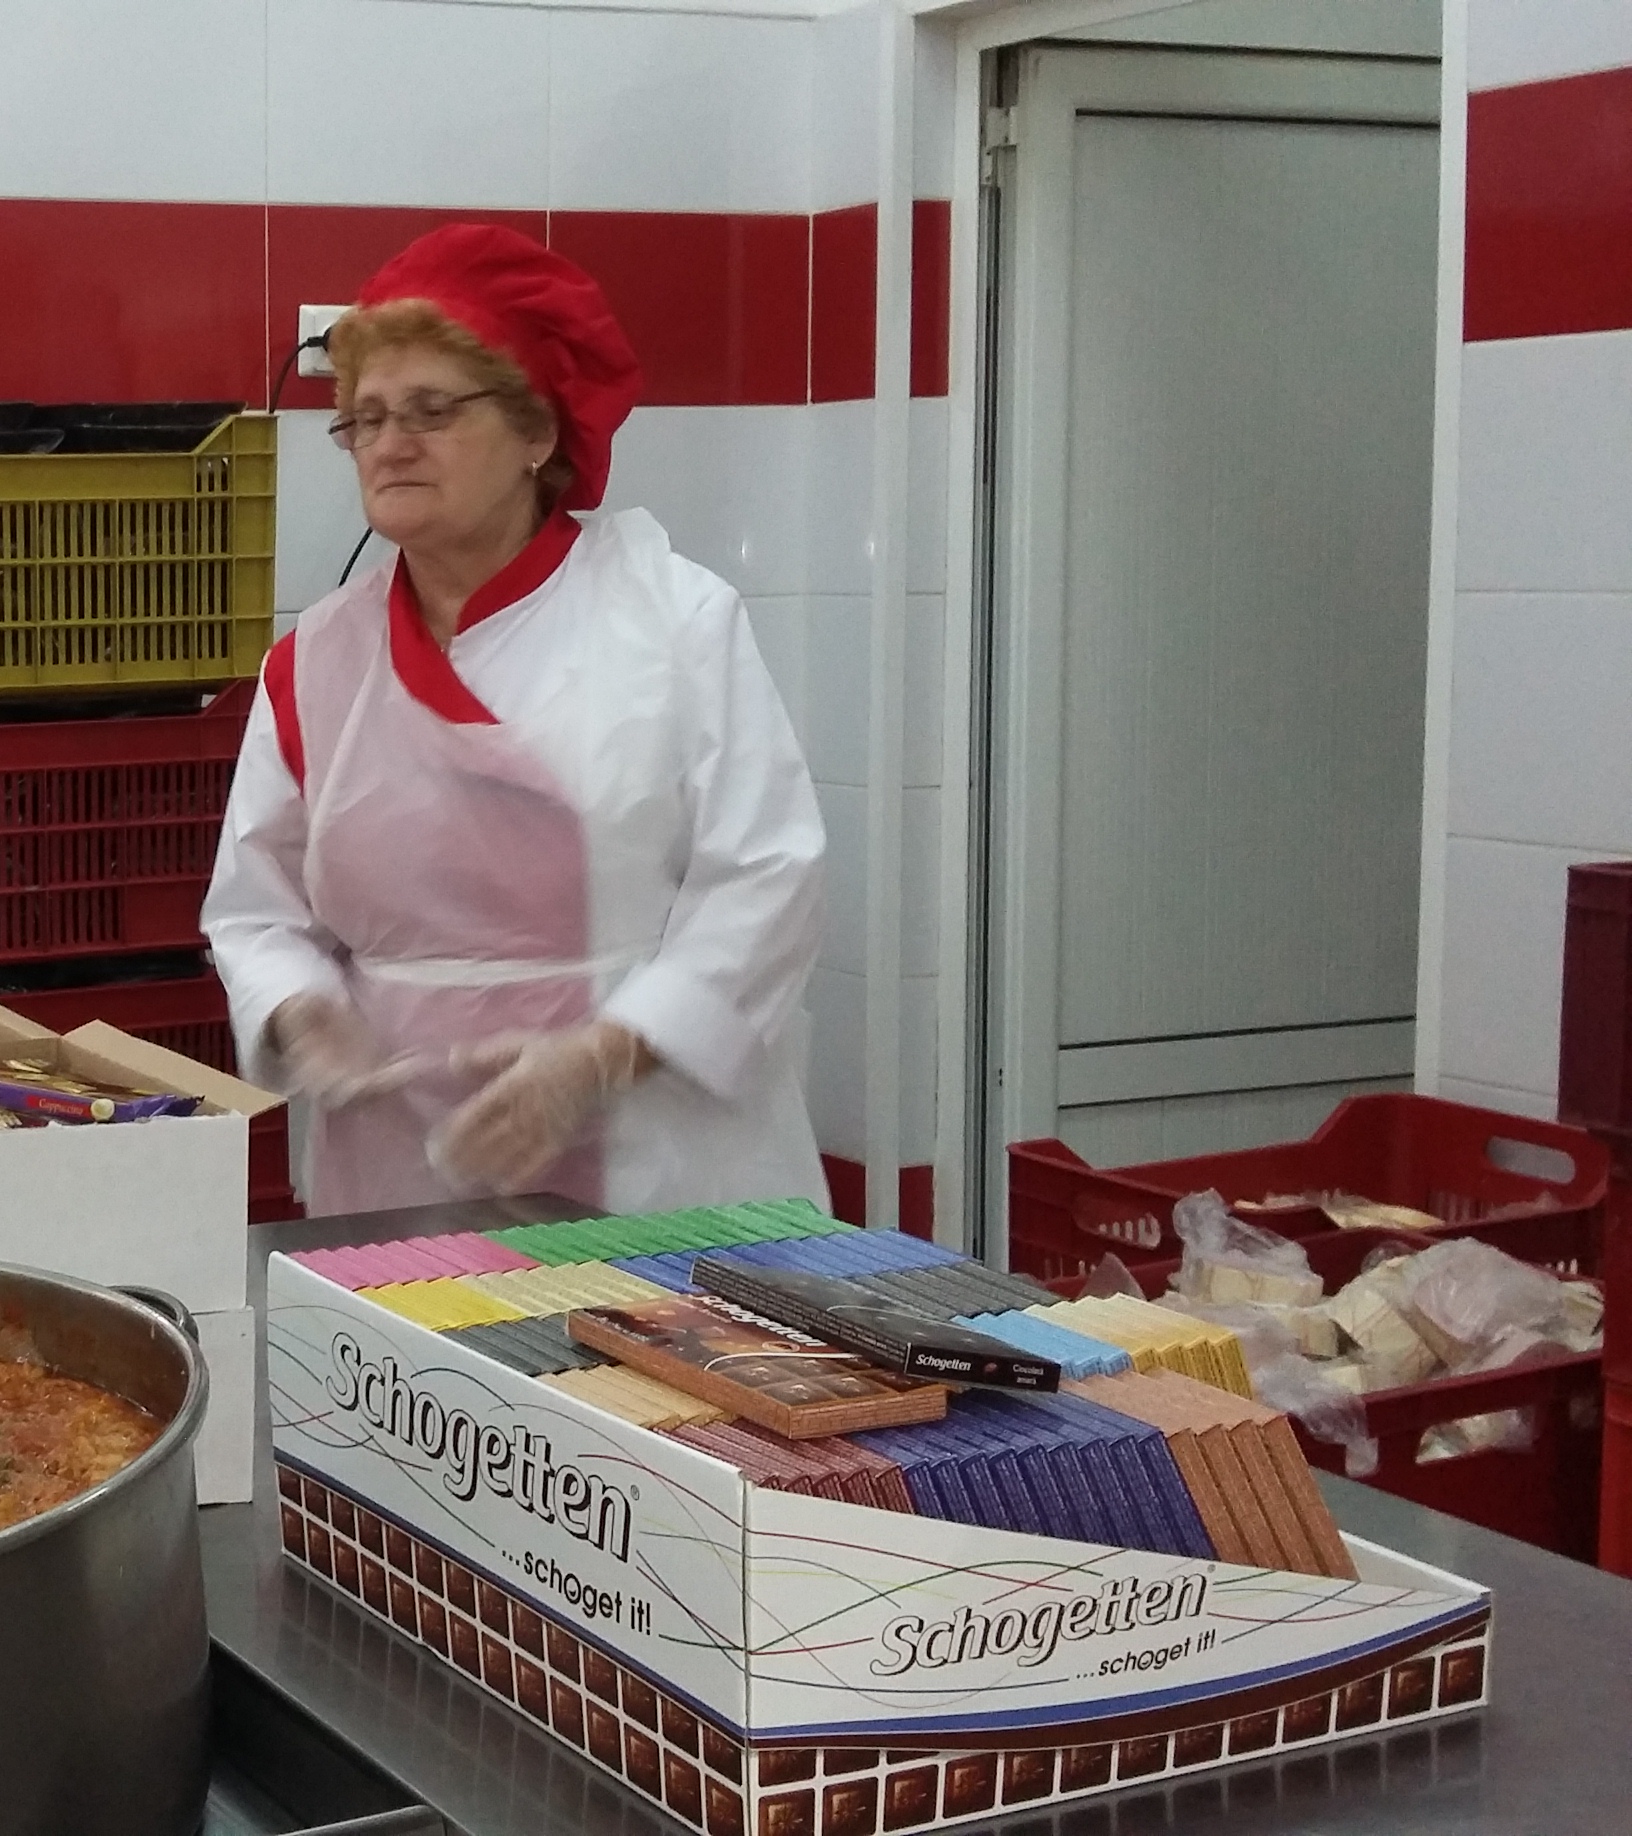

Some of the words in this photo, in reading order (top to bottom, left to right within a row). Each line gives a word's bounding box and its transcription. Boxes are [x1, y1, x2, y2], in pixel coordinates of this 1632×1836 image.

[916, 1354, 971, 1372] Schogetten
[326, 1332, 631, 1562] Schogetten
[631, 1597, 651, 1635] it!
[870, 1572, 1207, 1677] Schogetten
[1196, 1629, 1216, 1651] it!
